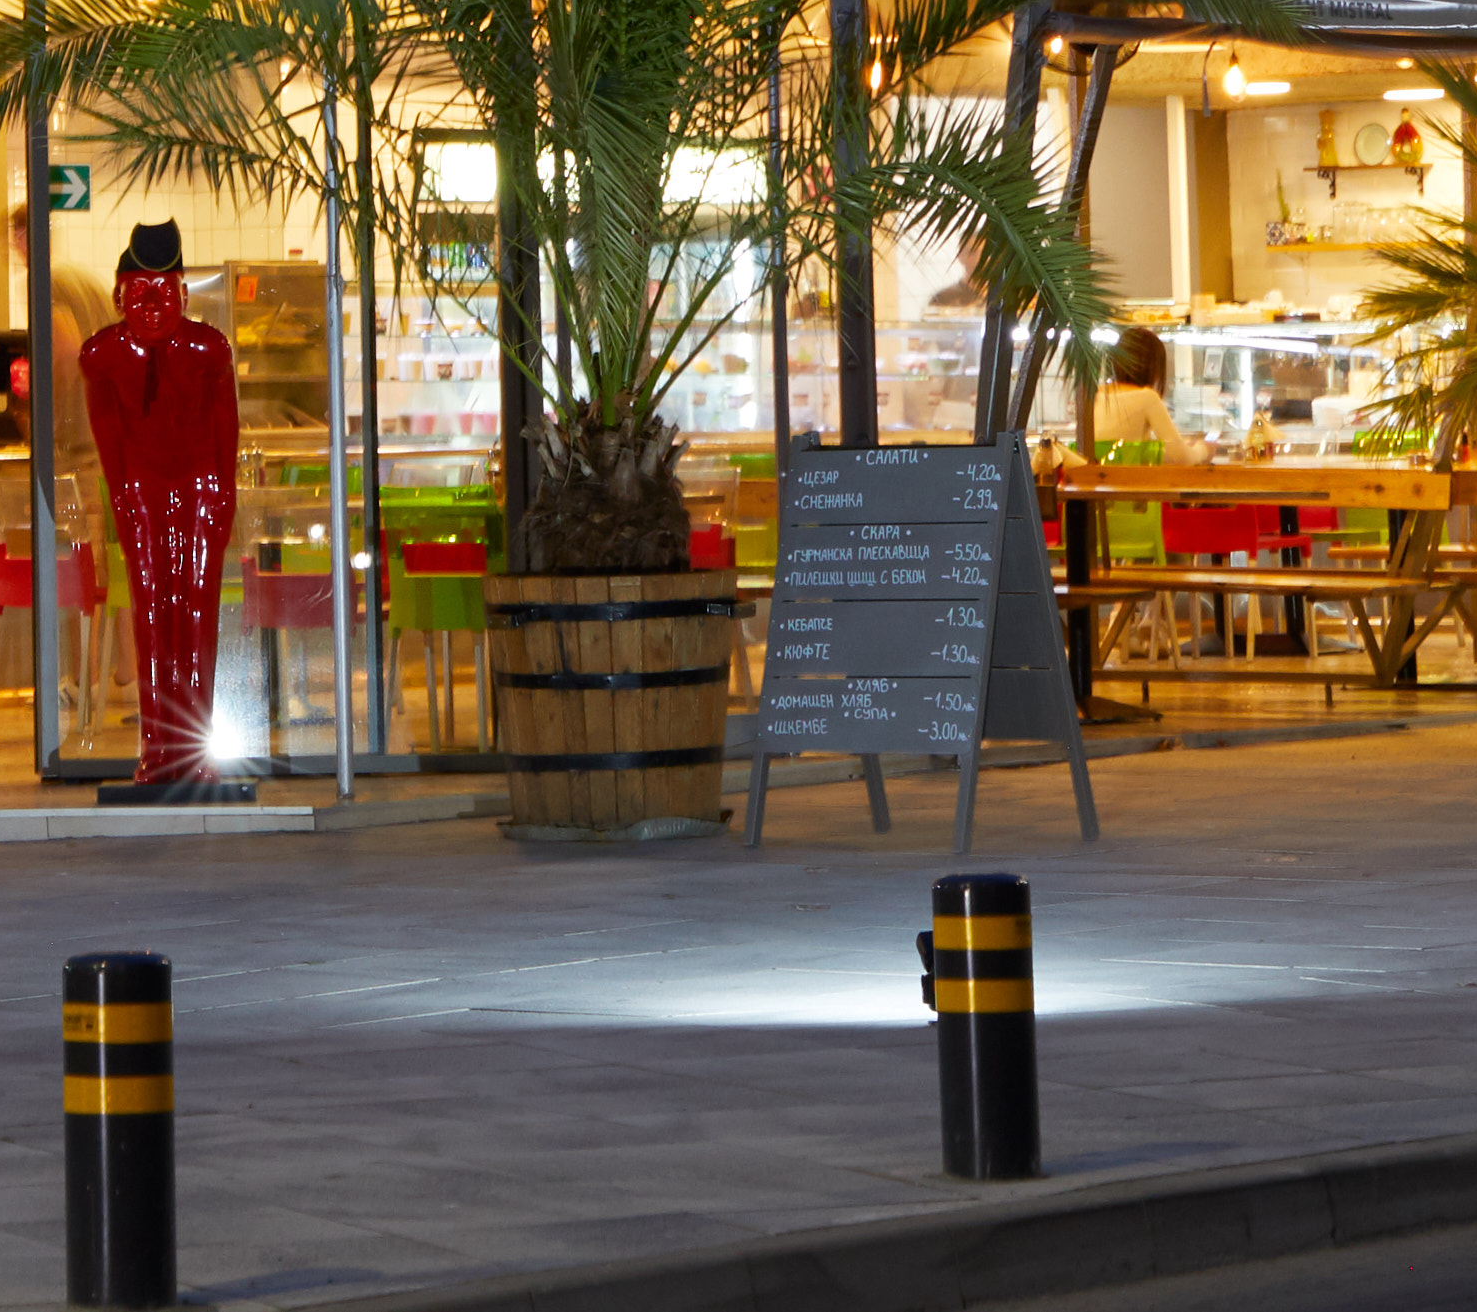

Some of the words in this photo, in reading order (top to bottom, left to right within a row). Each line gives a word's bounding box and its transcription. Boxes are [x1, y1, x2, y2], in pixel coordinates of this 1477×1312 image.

[1330, 0, 1393, 20] MISTRAL
[866, 450, 918, 465] САЛАТИ
[804, 471, 839, 487] ЦЕЗАР
[801, 493, 863, 509] СНЕЖАНКА
[861, 526, 900, 540] СКАРА
[794, 548, 853, 563] ГУРМАНСКА
[858, 545, 930, 561] ПЛЕСКАВИЦА
[791, 571, 843, 586] ПИЛЕШКИ
[881, 570, 888, 584] С
[892, 570, 926, 584] БЕКОН
[788, 618, 833, 631] КЕБАПЧЕ
[785, 644, 831, 660] КЮФТЕ
[856, 679, 889, 692] ХЛЯБ
[776, 695, 834, 711] ДОМАШЕН
[841, 694, 871, 707] ХЛЯБ
[854, 708, 888, 721] СУПА
[775, 719, 828, 734] ШКЕМБЕ
